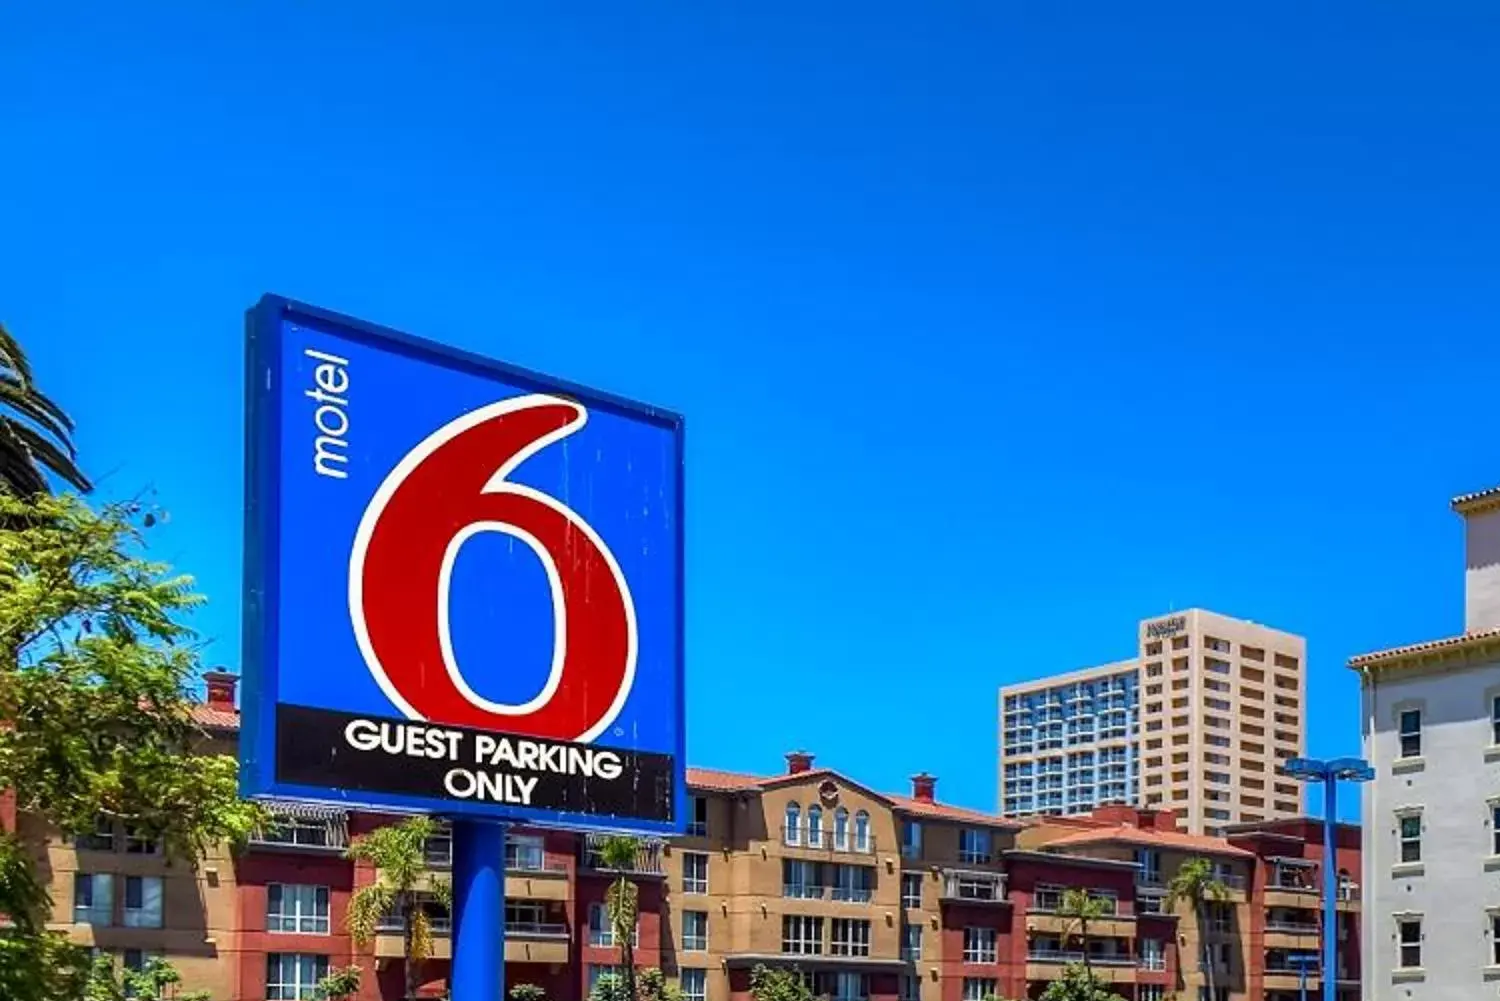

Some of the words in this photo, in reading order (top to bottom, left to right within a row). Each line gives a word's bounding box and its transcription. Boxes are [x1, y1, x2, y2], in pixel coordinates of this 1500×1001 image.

[305, 349, 350, 479] motel
[348, 393, 638, 746] 6
[345, 719, 463, 760] GUEST
[475, 735, 623, 780] PARKING
[444, 769, 539, 805] ONLY
